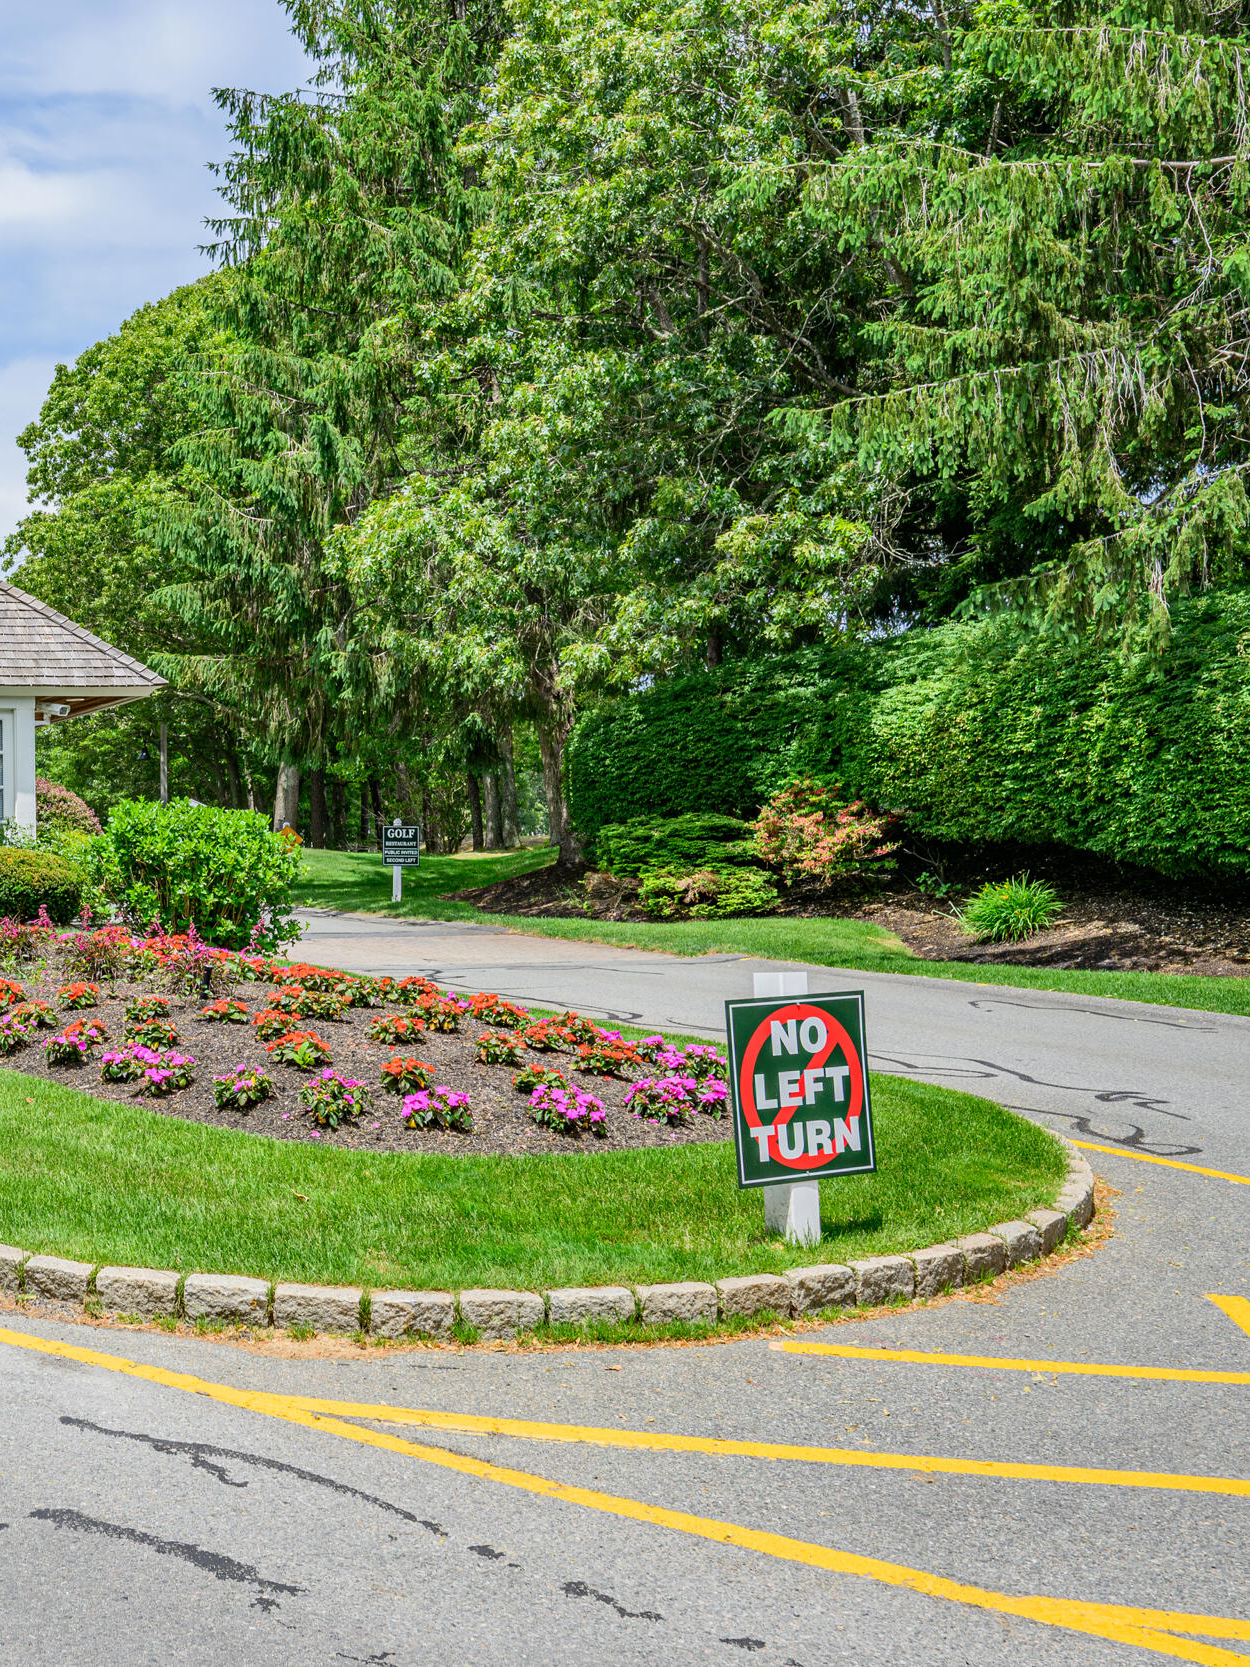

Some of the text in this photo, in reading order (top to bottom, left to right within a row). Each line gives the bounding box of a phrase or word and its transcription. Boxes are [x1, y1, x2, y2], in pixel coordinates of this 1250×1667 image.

[387, 829, 415, 838] GOLF
[770, 1016, 828, 1056] NO
[754, 1065, 849, 1110] LEFT
[750, 1116, 861, 1162] TURN
